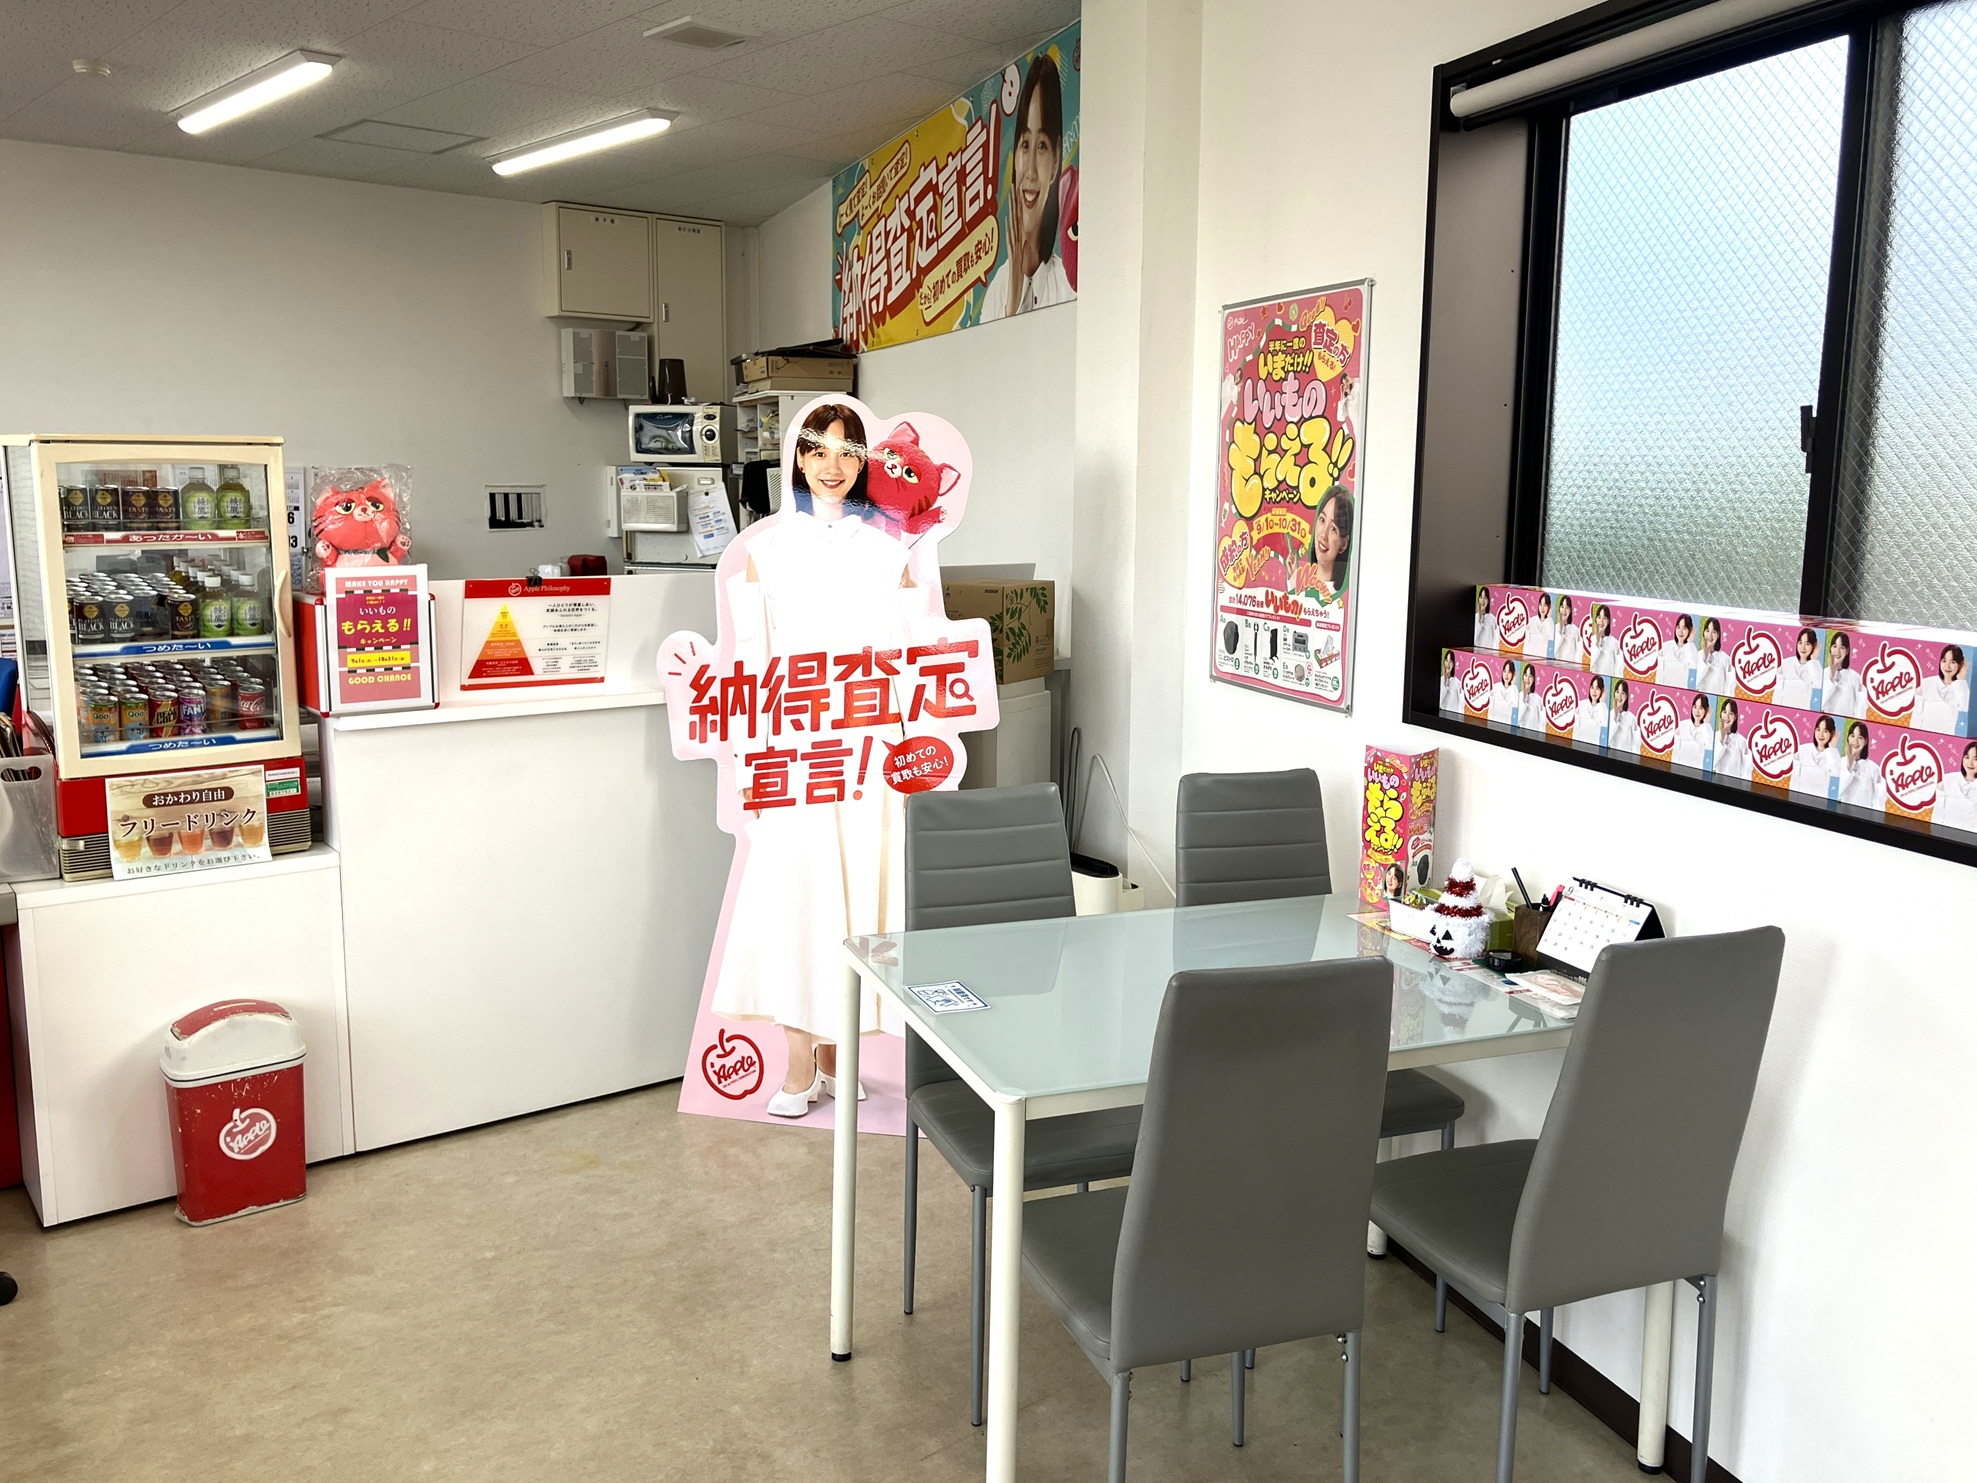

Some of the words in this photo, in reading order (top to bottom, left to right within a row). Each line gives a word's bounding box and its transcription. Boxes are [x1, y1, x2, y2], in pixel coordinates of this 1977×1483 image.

[841, 101, 998, 342] 納得査定宣言!
[932, 227, 995, 304] 初めての買取も安心!
[1312, 320, 1352, 367] 査定の方
[1243, 372, 1327, 429] いいもの
[1228, 416, 1354, 519] もらえる!!
[1263, 489, 1301, 505] キャンペーン
[92, 510, 119, 519] BLACK
[345, 580, 367, 588] MAKE
[367, 579, 384, 587] YOU
[385, 578, 409, 587] HAPPY
[359, 605, 397, 616] いいもの
[79, 622, 105, 631] BLACK
[109, 620, 135, 630] BLACK
[360, 636, 397, 645] キャンペーン
[1626, 636, 1657, 660] Apple
[1738, 652, 1776, 679] Apple
[348, 675, 375, 685] GOOD
[688, 637, 980, 744] 納得査定
[1869, 673, 1915, 700] Apple
[93, 712, 109, 720] Qoo
[127, 709, 145, 718] Qoo
[155, 708, 177, 718] REAL
[1547, 694, 1575, 717] Apple
[1642, 714, 1675, 738] Apple
[893, 745, 937, 769] 初めての
[1754, 738, 1793, 763] Apple
[742, 735, 875, 811] 宣言!
[890, 755, 949, 785] 買取も安心!
[1367, 767, 1400, 790] いいもの
[1889, 764, 1936, 794] Apple
[152, 788, 226, 806] おかわり自由
[119, 807, 258, 838] フリードリンク
[126, 853, 261, 875] お好きなドリンクをお選び下さい。
[1567, 886, 1574, 896] 9
[710, 1055, 757, 1085] Apple
[225, 1119, 271, 1153] Apple
